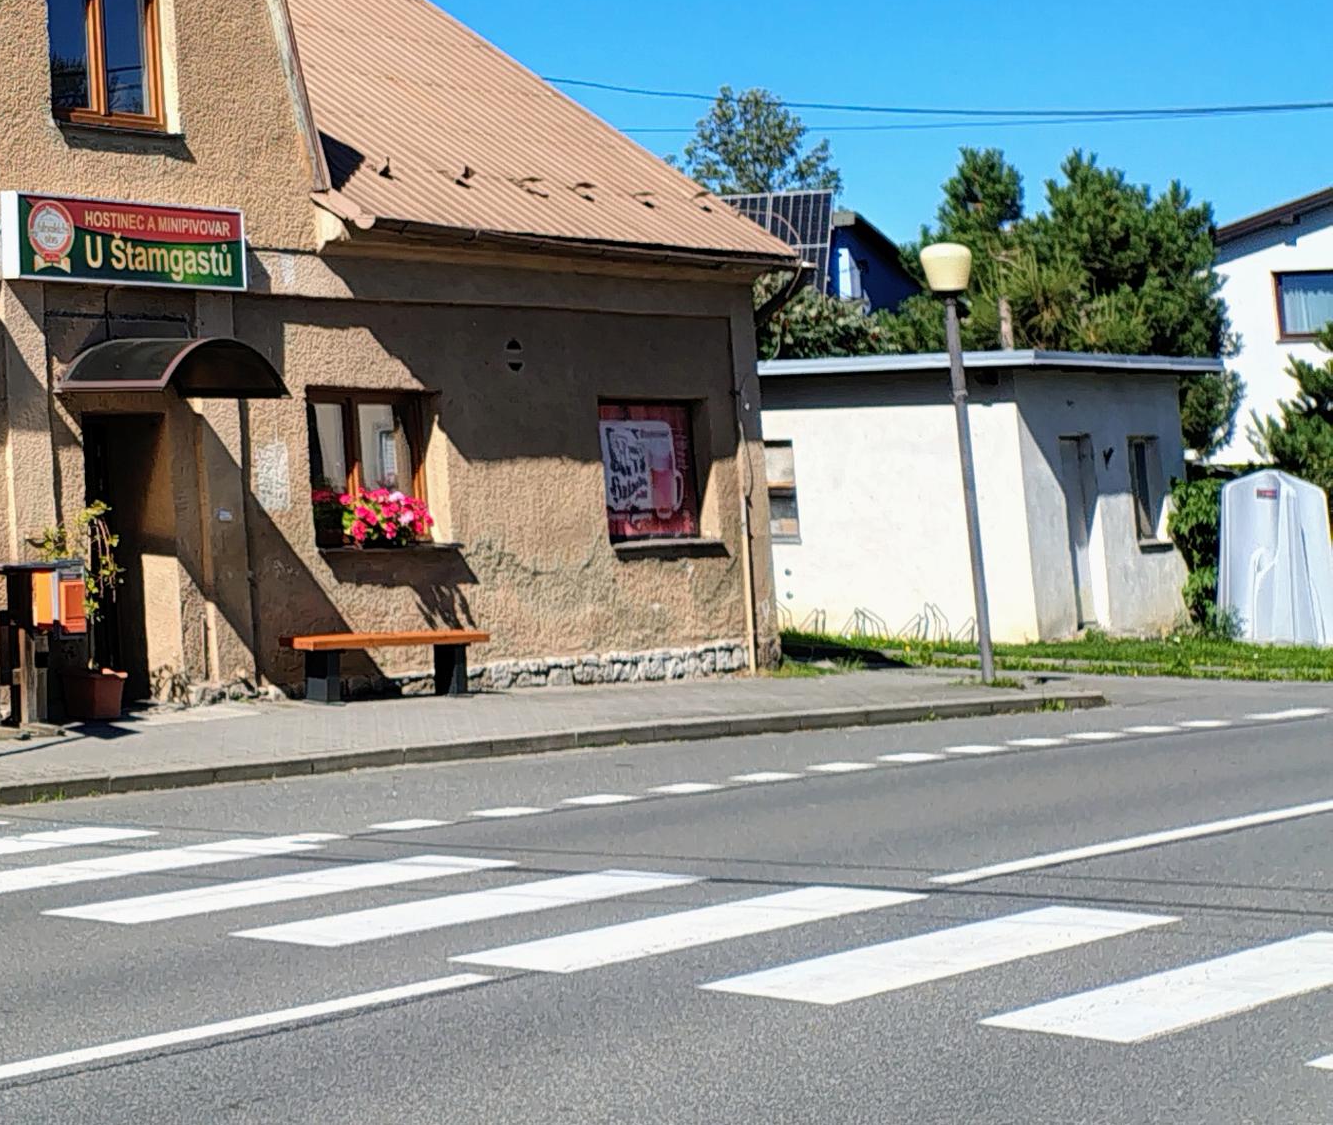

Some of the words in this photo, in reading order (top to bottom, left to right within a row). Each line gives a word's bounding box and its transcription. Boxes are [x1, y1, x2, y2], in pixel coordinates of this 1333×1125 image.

[85, 210, 145, 230] HOSTINEC
[147, 215, 157, 232] A
[158, 217, 231, 237] MINIPIVOVAR
[85, 234, 104, 269] U
[110, 231, 233, 282] Štamgastů
